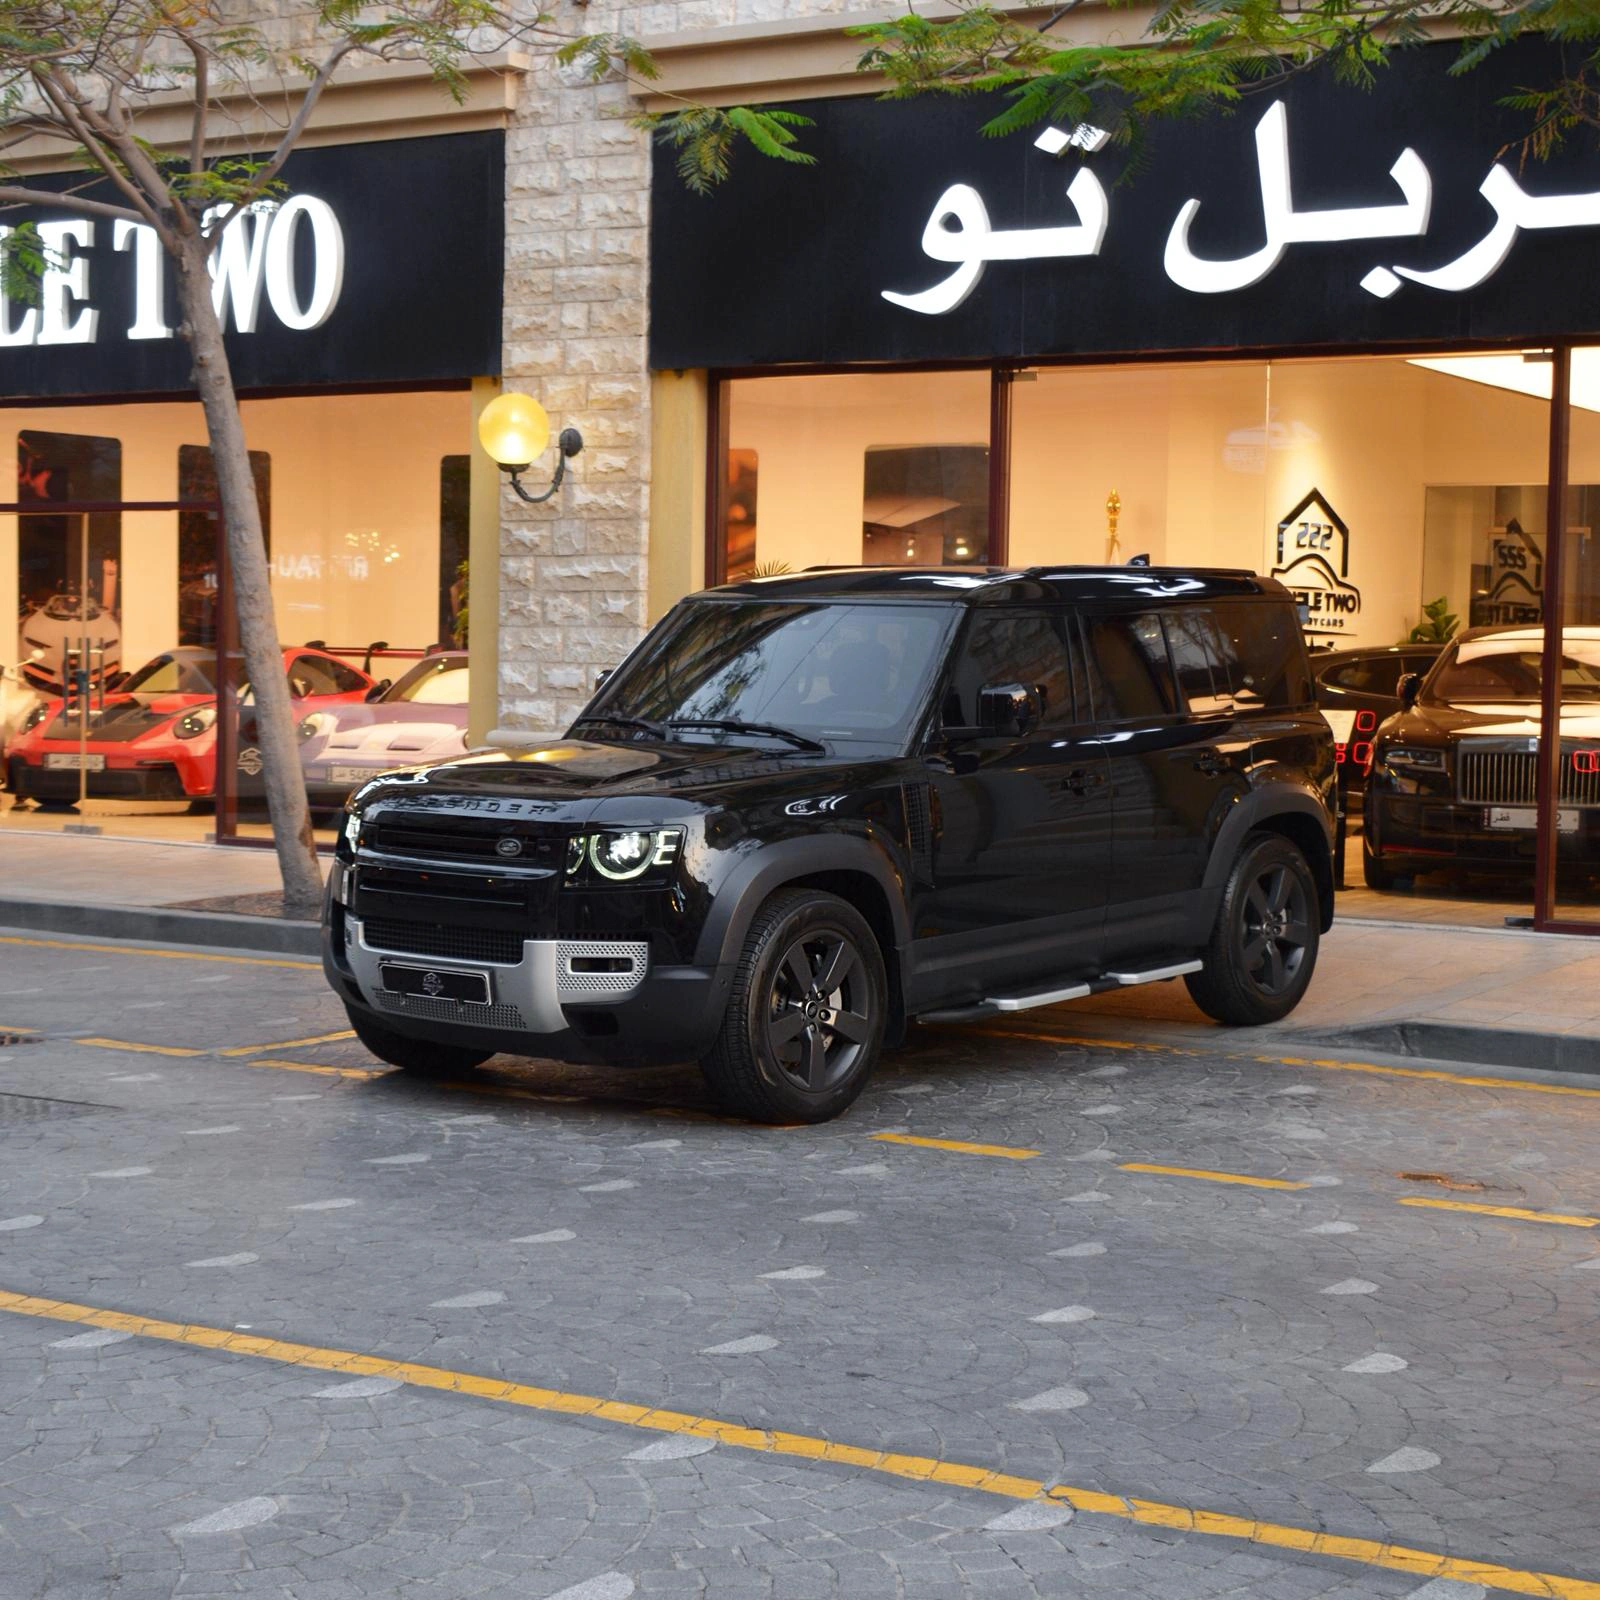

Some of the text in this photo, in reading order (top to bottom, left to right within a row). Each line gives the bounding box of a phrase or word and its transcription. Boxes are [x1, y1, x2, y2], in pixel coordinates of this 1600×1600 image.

[881, 100, 1600, 315] ربل تو
[113, 194, 345, 340] TWO
[1296, 522, 1333, 550] 222
[1325, 593, 1357, 613] TWO
[1320, 618, 1345, 628] CARS
